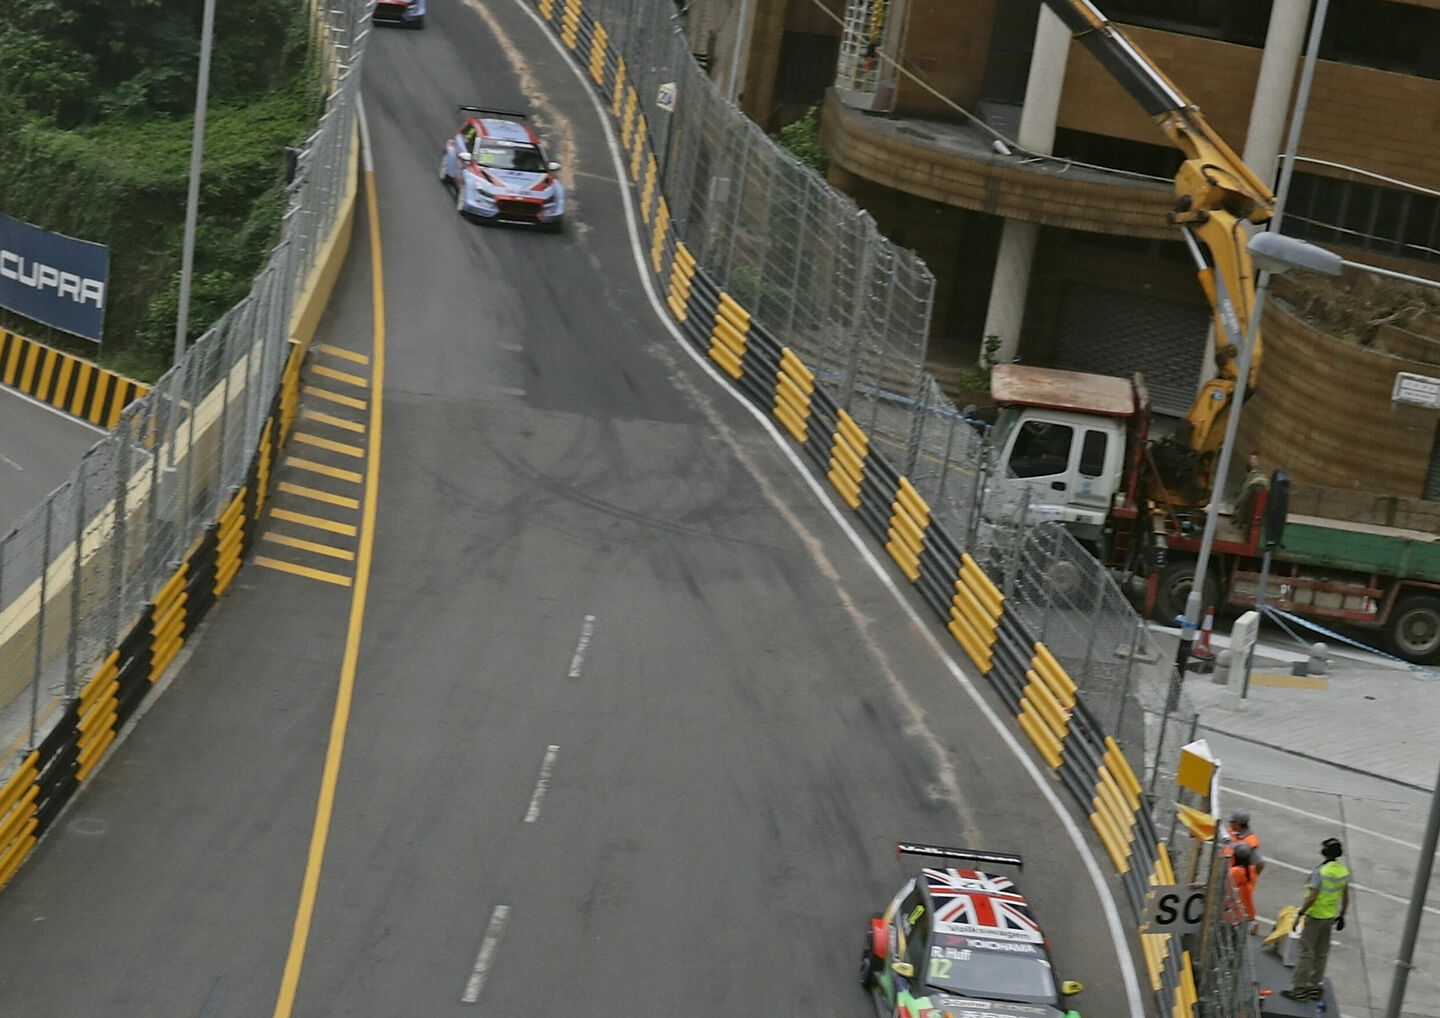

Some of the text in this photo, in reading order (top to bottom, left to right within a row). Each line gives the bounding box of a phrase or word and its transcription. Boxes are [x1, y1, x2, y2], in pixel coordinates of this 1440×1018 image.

[1156, 892, 1205, 926] SC
[965, 938, 1037, 953] YOKOHAMA
[930, 957, 954, 979] 12
